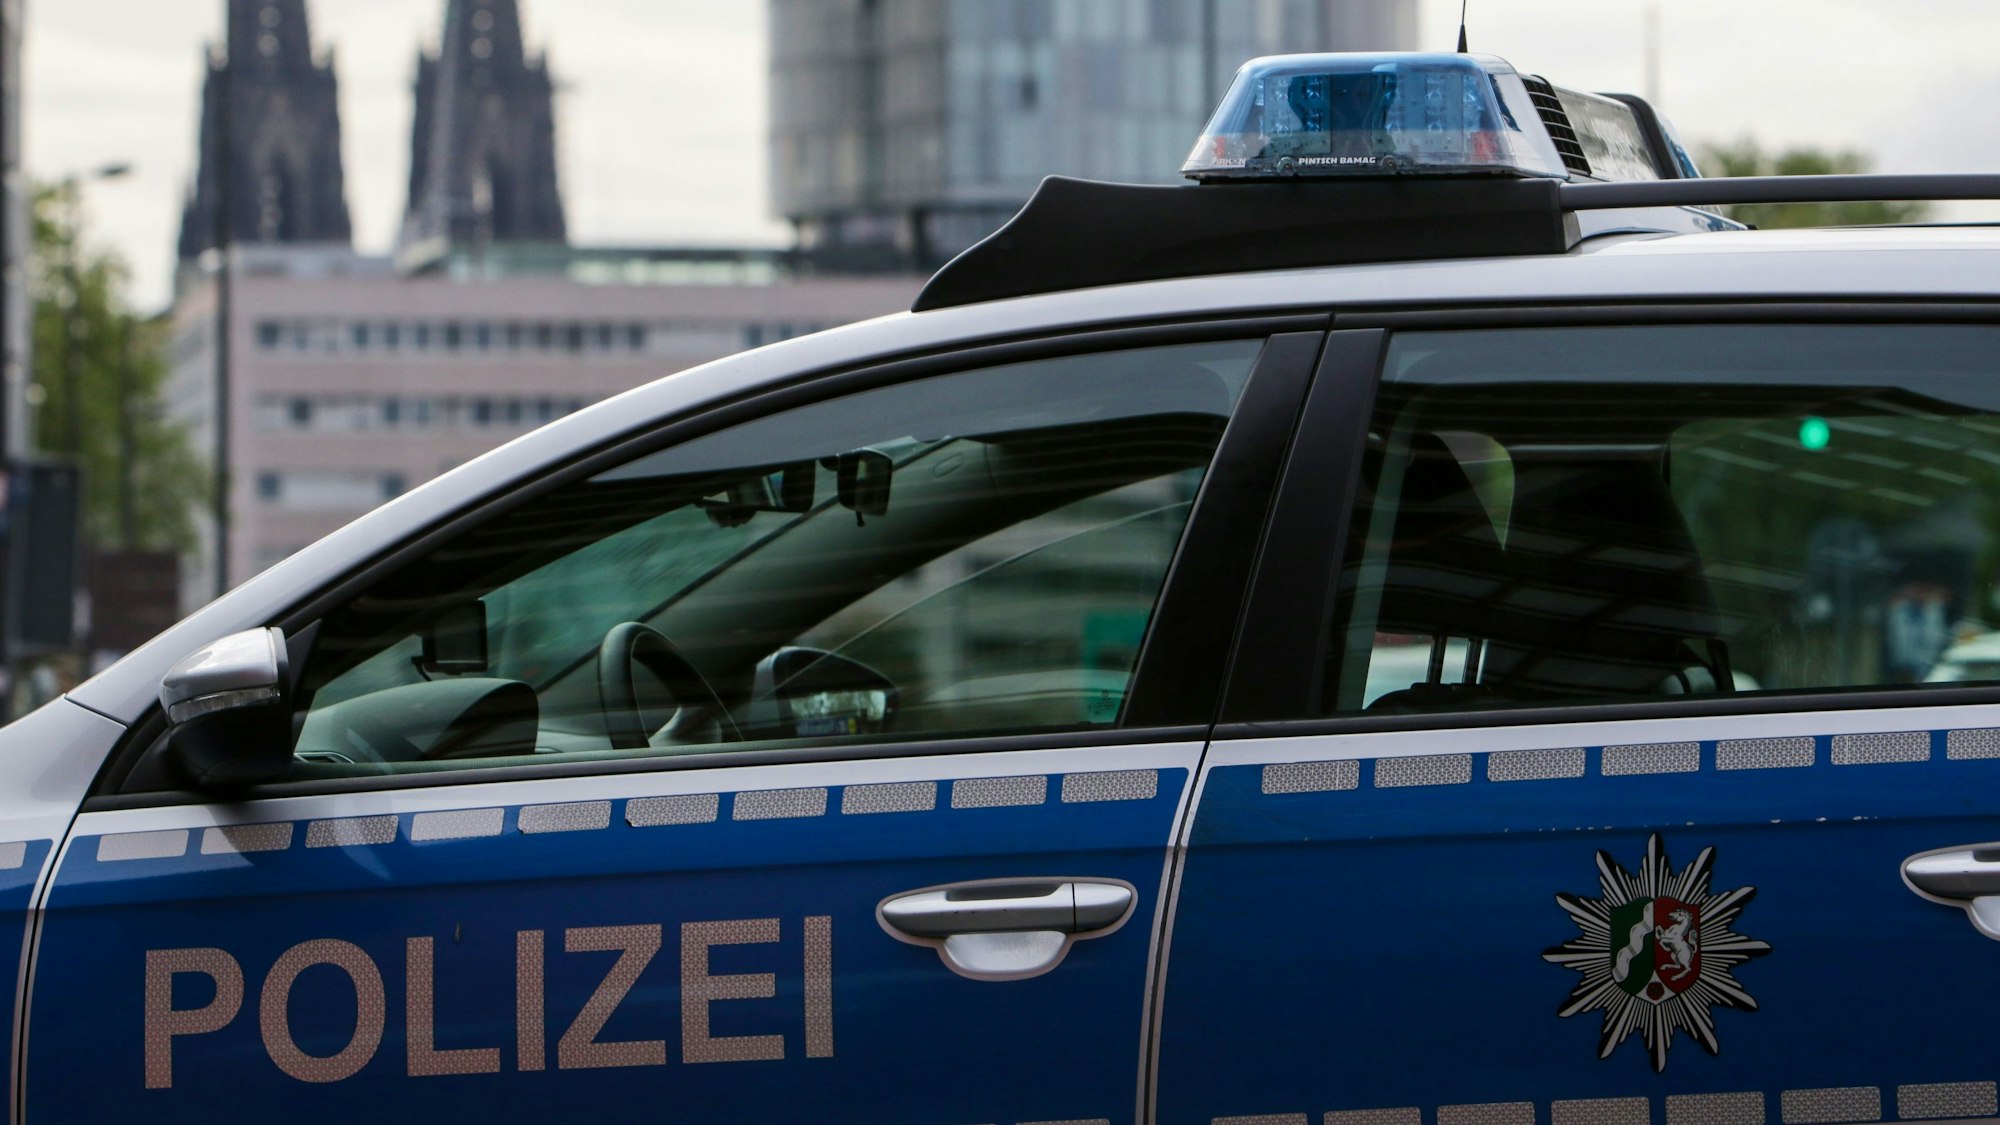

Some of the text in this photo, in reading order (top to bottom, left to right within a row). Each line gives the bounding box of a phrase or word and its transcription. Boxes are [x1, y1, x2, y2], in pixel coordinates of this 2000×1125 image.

[1298, 156, 1376, 165] PINTSCH BAMAG
[144, 915, 834, 1090] POLIZEI
